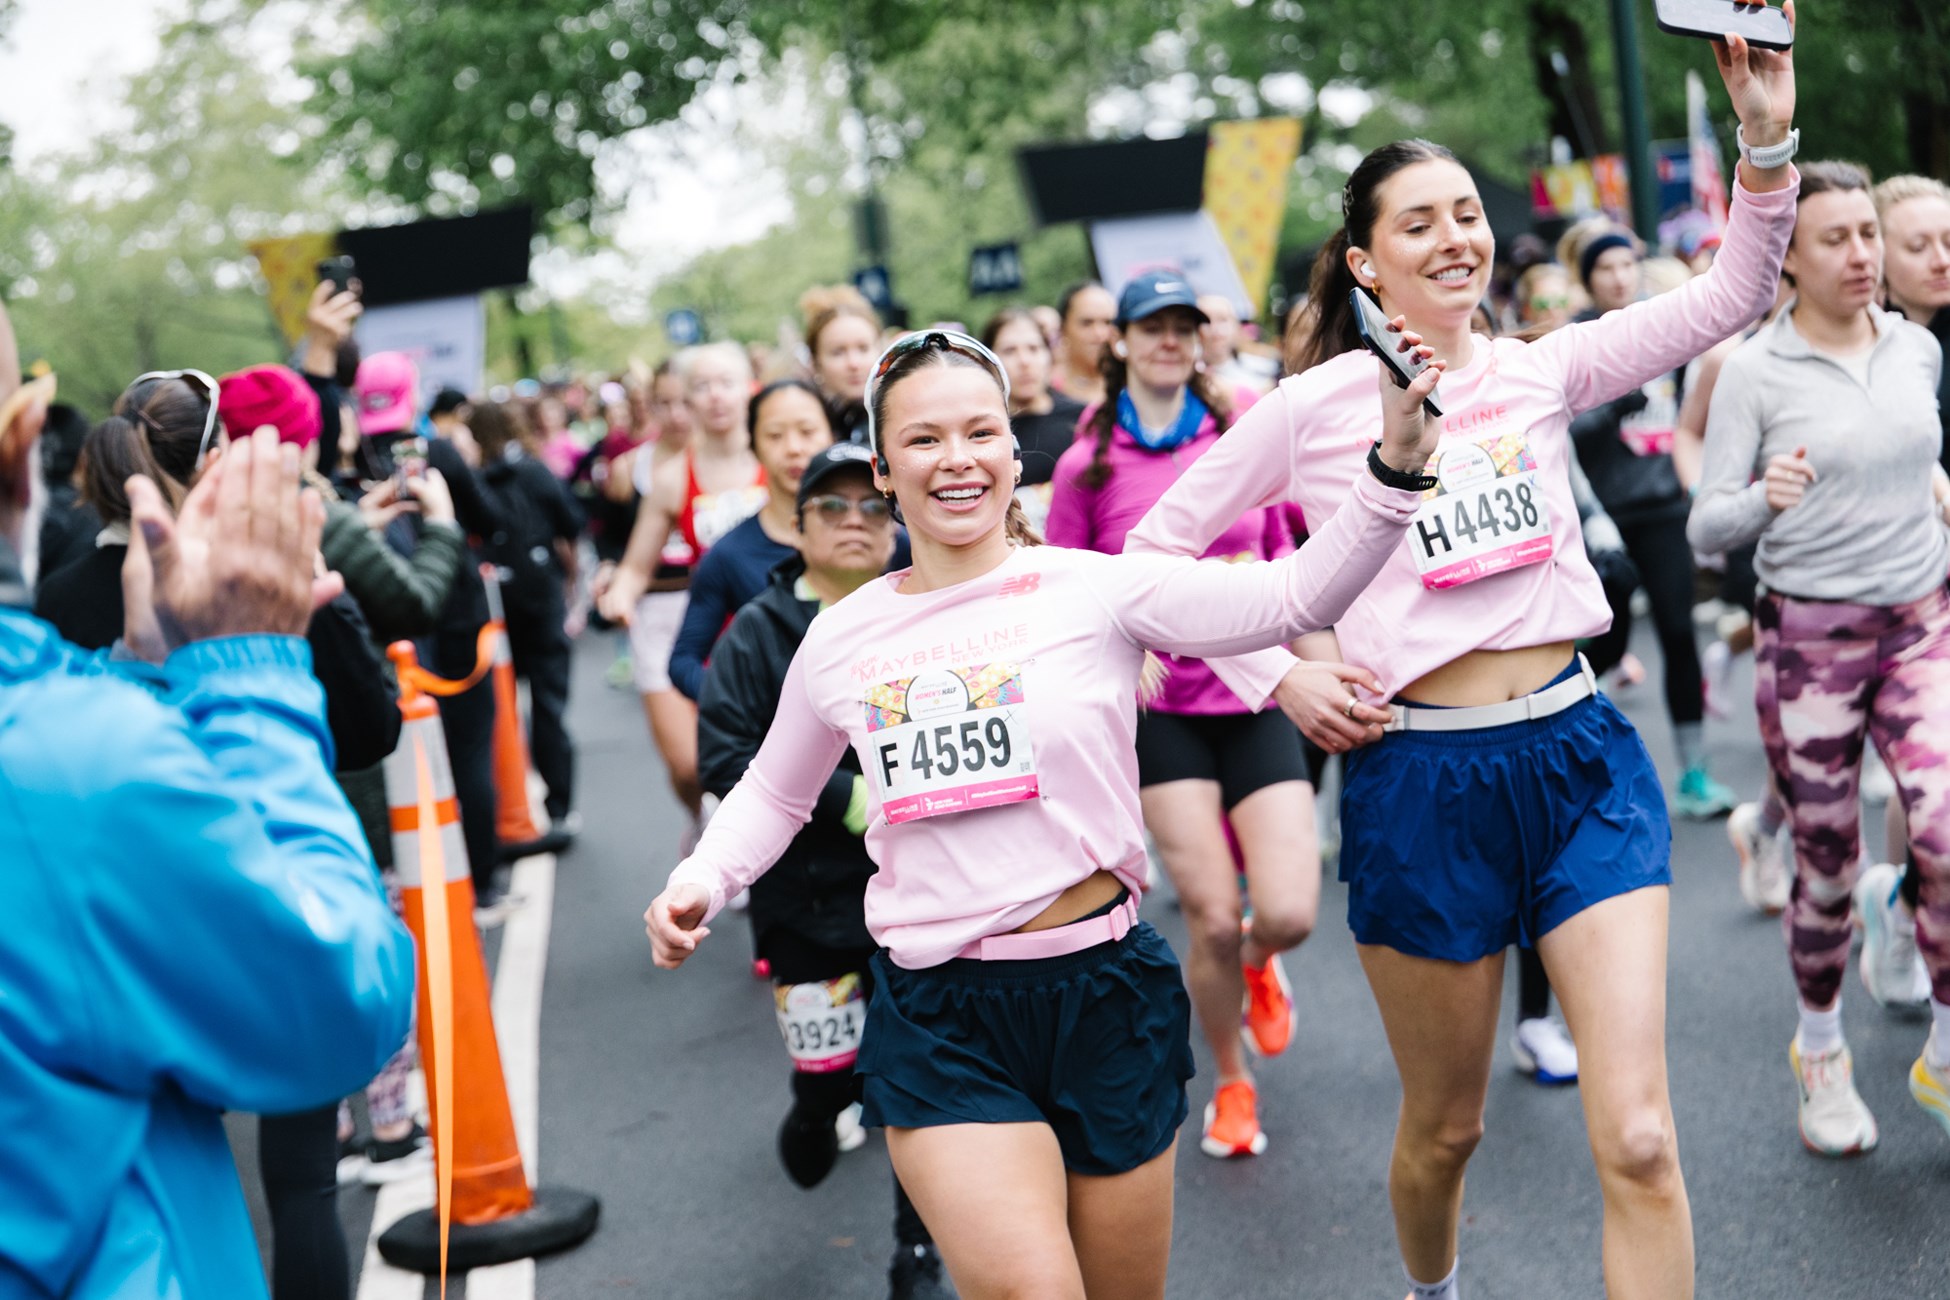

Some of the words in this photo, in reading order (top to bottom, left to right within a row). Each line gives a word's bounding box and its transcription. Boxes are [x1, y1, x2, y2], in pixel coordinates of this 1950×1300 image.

[1446, 404, 1508, 433] LLINE
[1416, 514, 1452, 558] H
[1454, 483, 1538, 544] 4438
[859, 623, 1029, 683] MAYBELLINE
[952, 650, 984, 664] NEW
[988, 637, 1030, 653] YORK
[879, 743, 899, 788] F
[911, 717, 1011, 780] 4559
